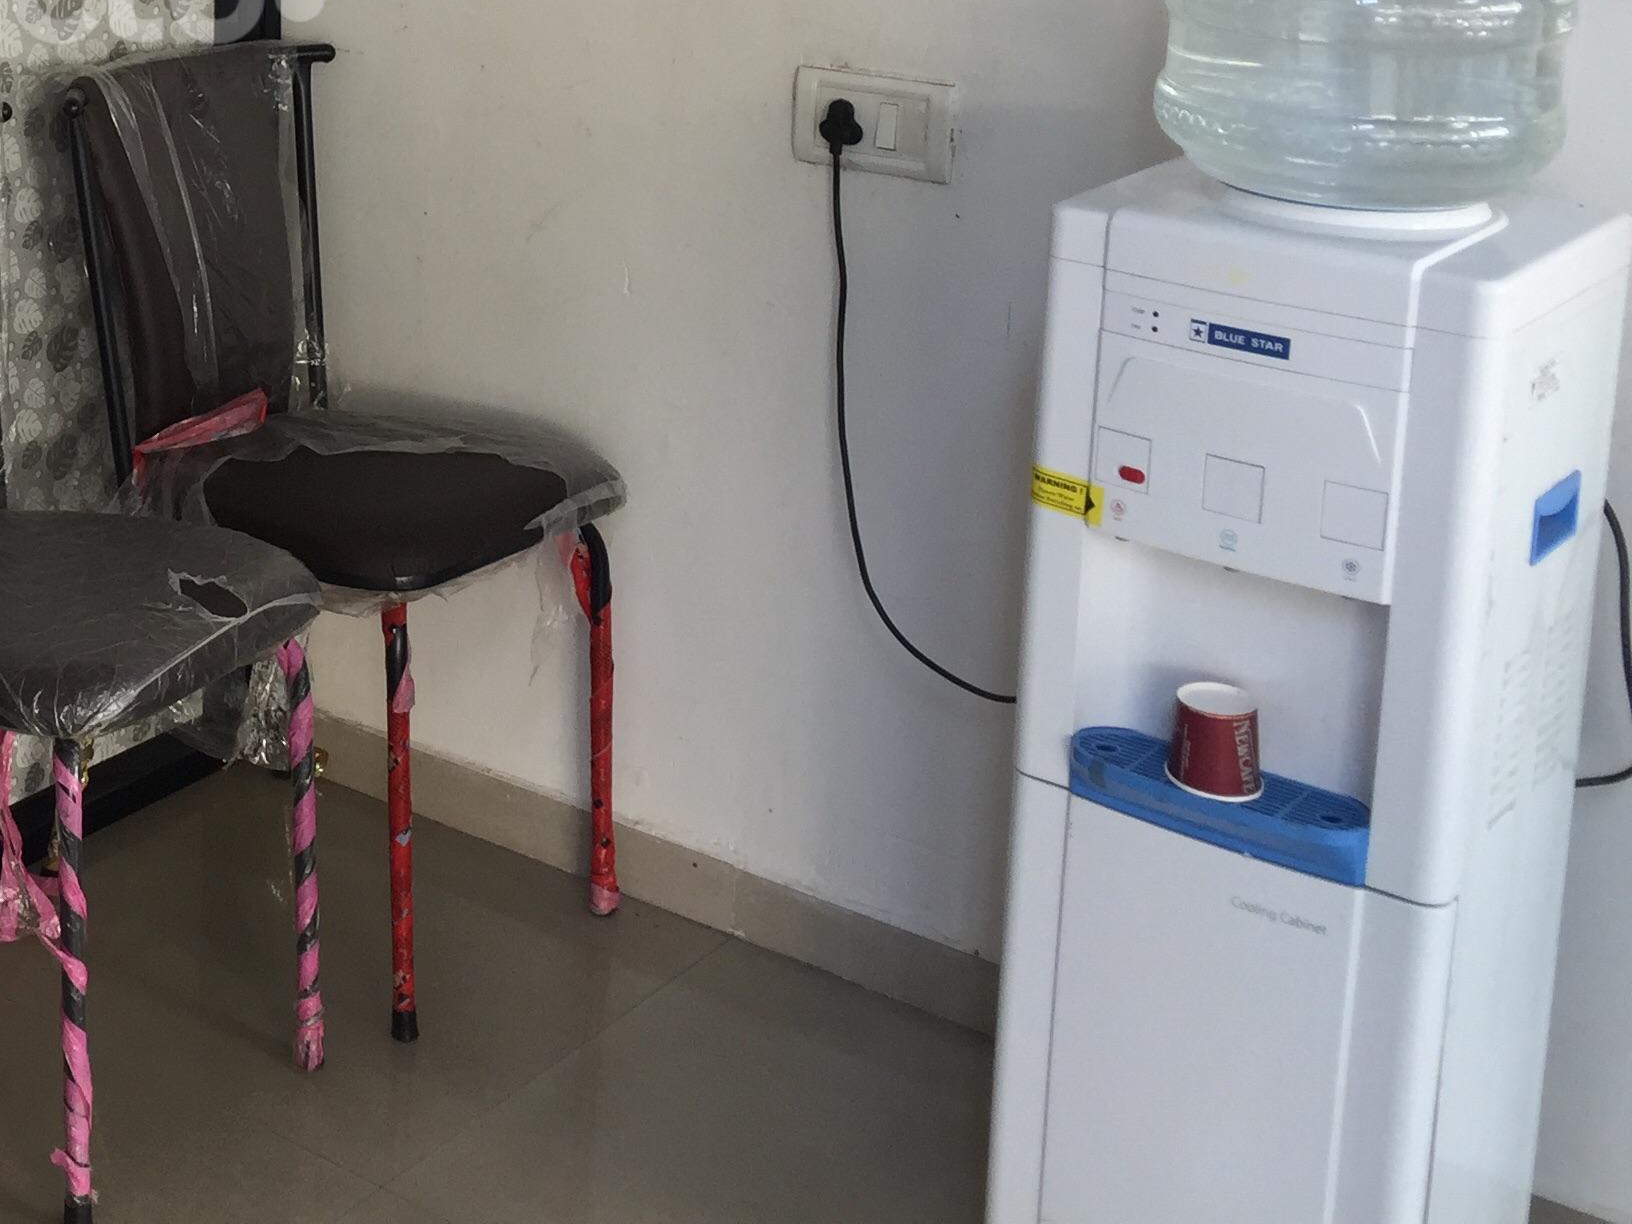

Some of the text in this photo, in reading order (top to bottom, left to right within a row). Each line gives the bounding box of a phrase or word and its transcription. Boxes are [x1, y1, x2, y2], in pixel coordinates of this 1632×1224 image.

[1214, 330, 1284, 353] BLUE STAR
[1230, 896, 1327, 936] Cooling Cabinet
